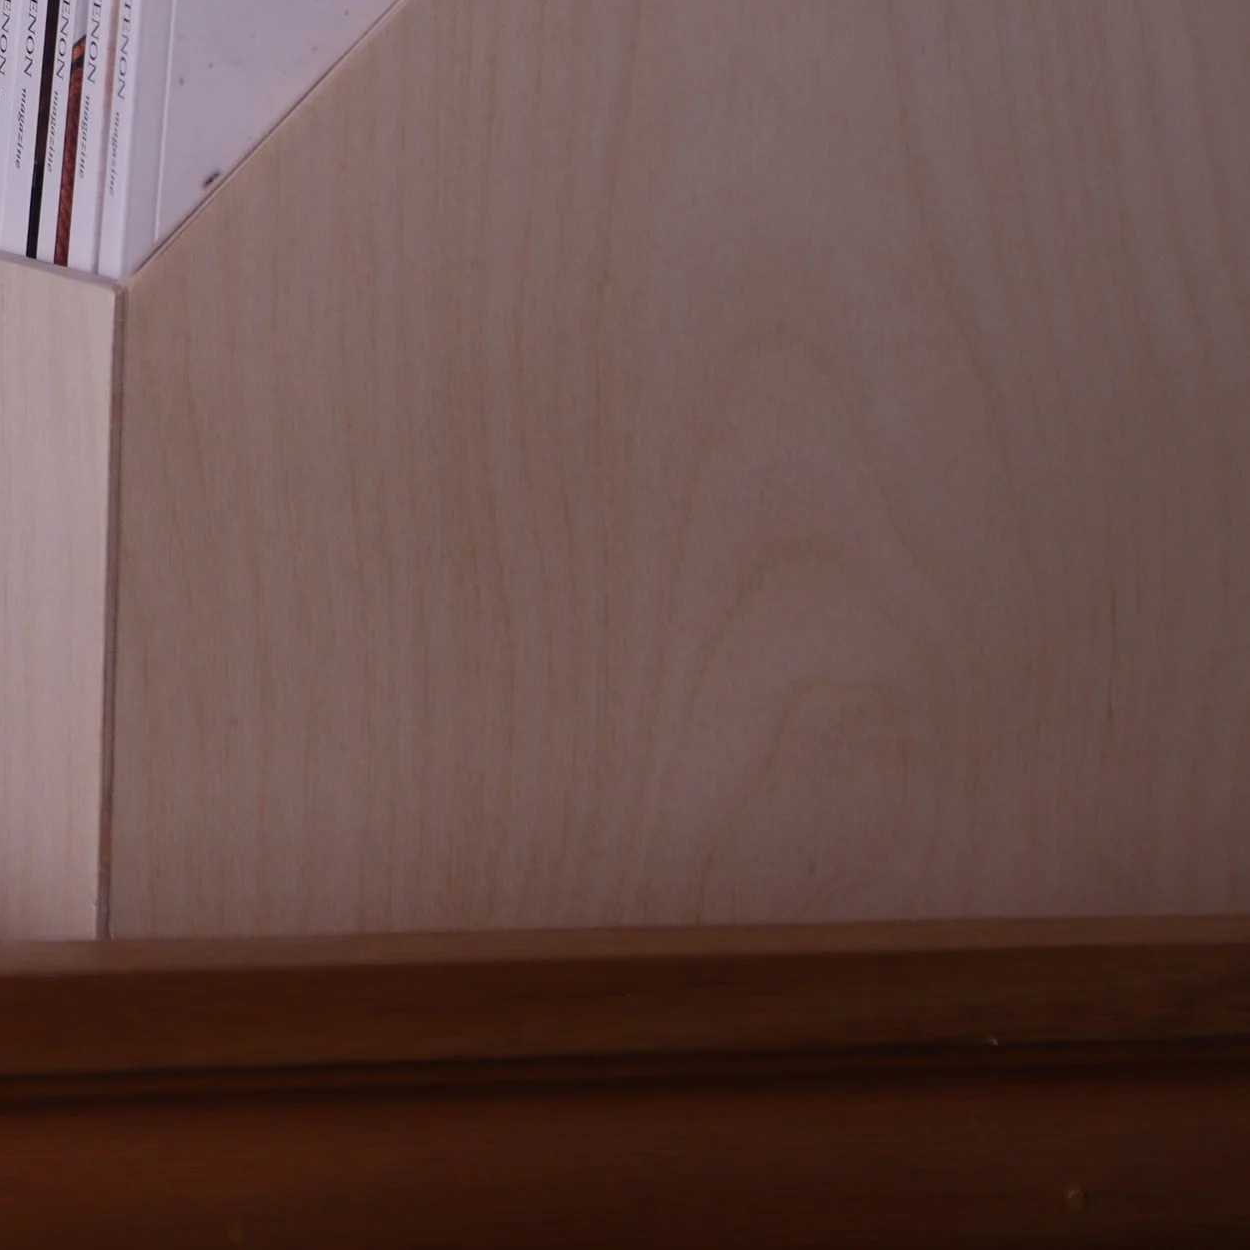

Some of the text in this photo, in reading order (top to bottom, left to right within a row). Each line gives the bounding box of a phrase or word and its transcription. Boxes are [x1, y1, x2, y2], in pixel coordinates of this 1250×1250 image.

[16, 88, 27, 169] magazine
[47, 91, 58, 172] magazine
[78, 95, 90, 179] magazine
[109, 111, 121, 196] magazine
